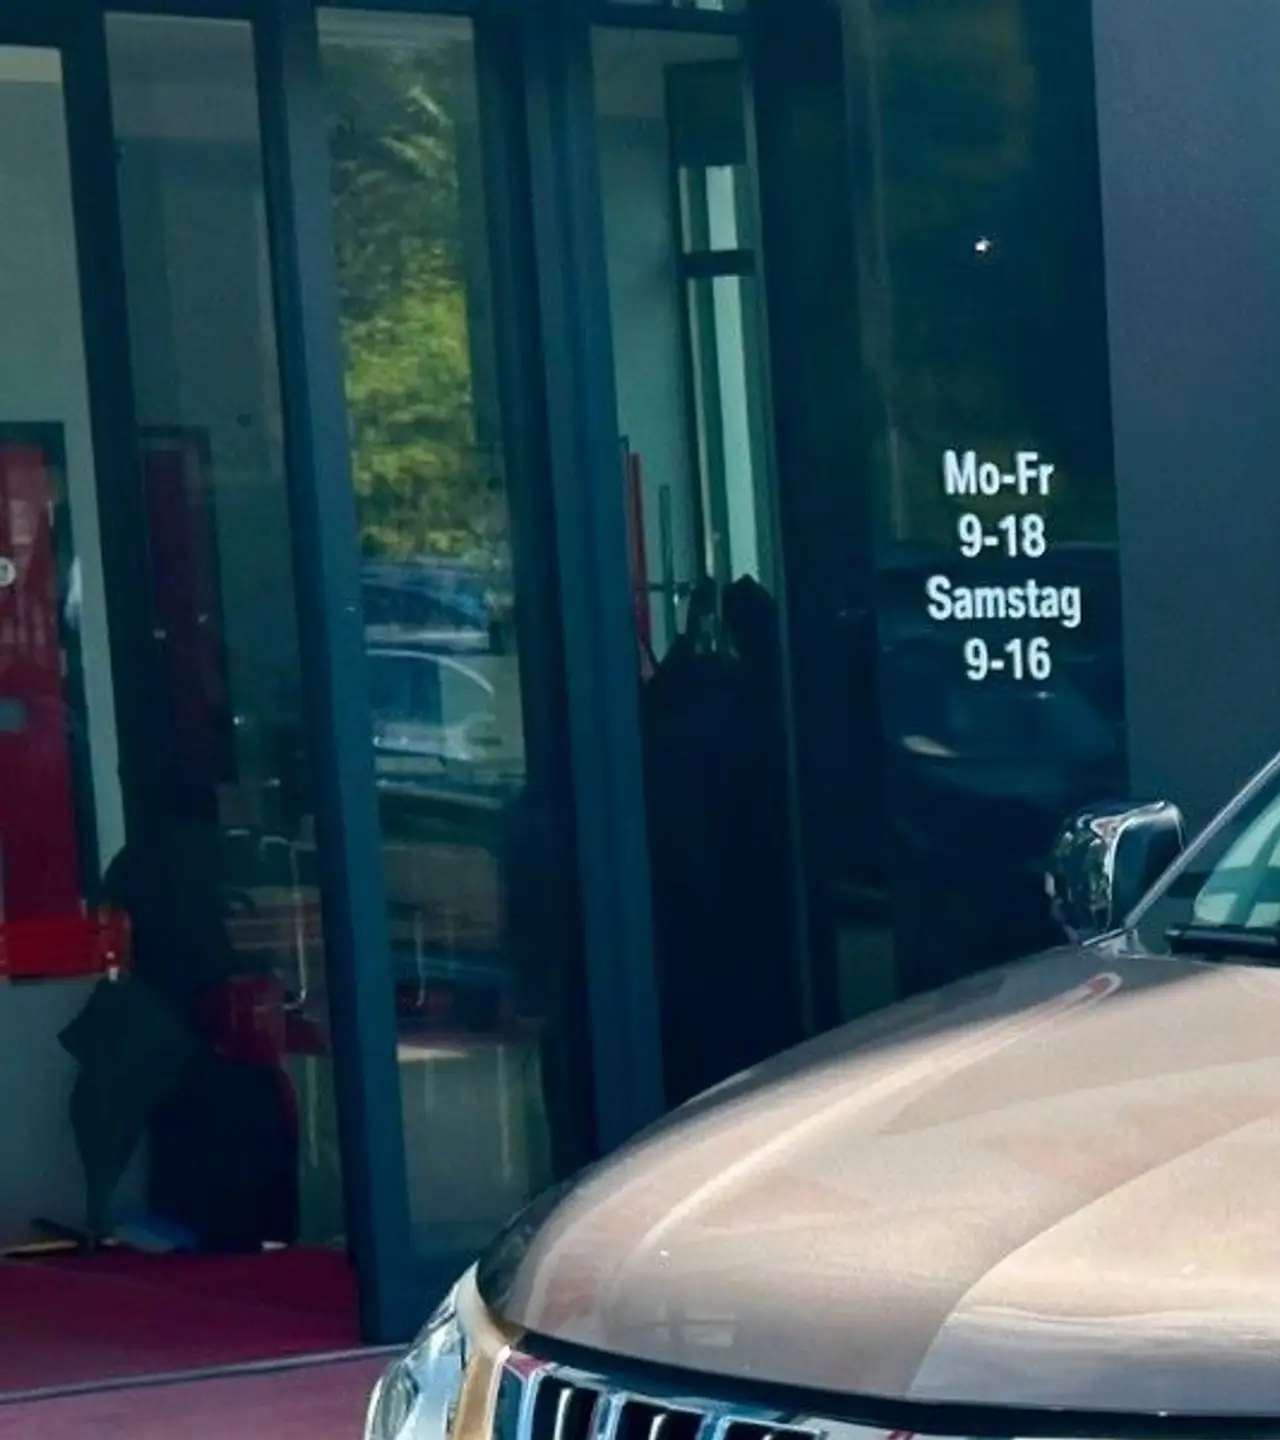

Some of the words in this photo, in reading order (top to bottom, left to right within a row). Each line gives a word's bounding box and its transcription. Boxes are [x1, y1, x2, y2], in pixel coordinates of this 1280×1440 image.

[943, 449, 1055, 495] Mo-Fr
[958, 512, 1046, 558] 9-18
[926, 574, 1082, 628] Samstag
[964, 636, 1052, 681] 9-16
